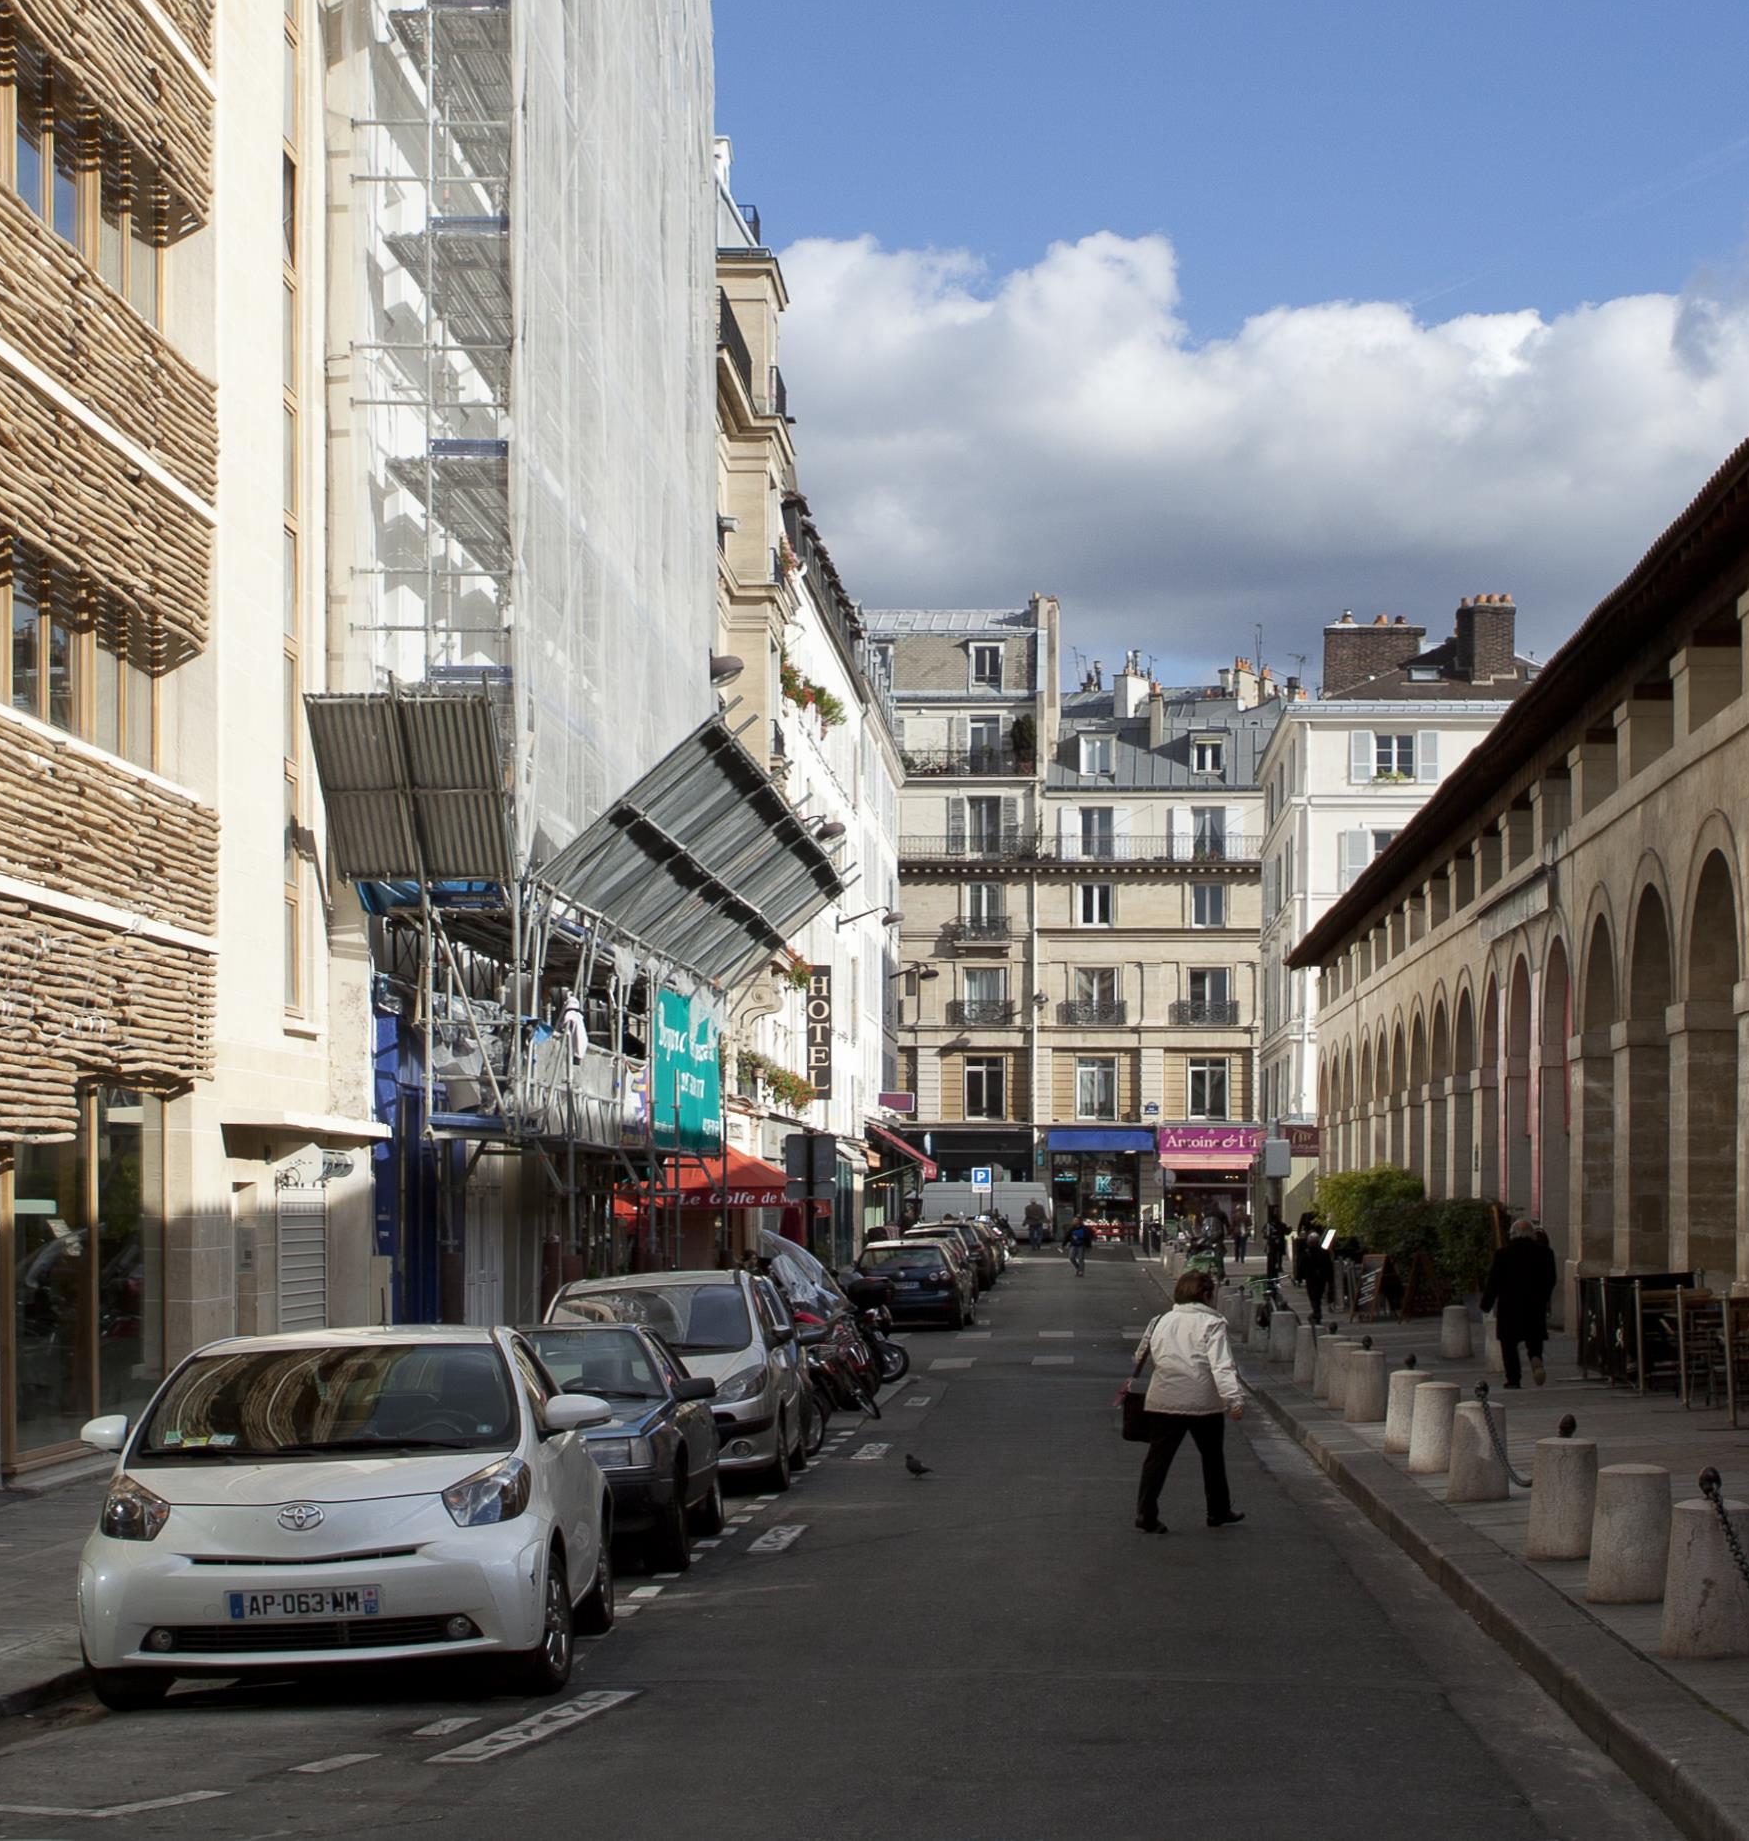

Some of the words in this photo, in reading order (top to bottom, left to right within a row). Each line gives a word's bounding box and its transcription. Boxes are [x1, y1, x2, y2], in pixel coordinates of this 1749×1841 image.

[807, 975, 831, 1091] HOTEL
[1222, 1134, 1238, 1148] &
[679, 1192, 700, 1207] Le
[709, 1191, 756, 1205] Golfe
[761, 1192, 777, 1204] de
[249, 1591, 360, 1616] AP-063-NM
[363, 1602, 378, 1614] 75
